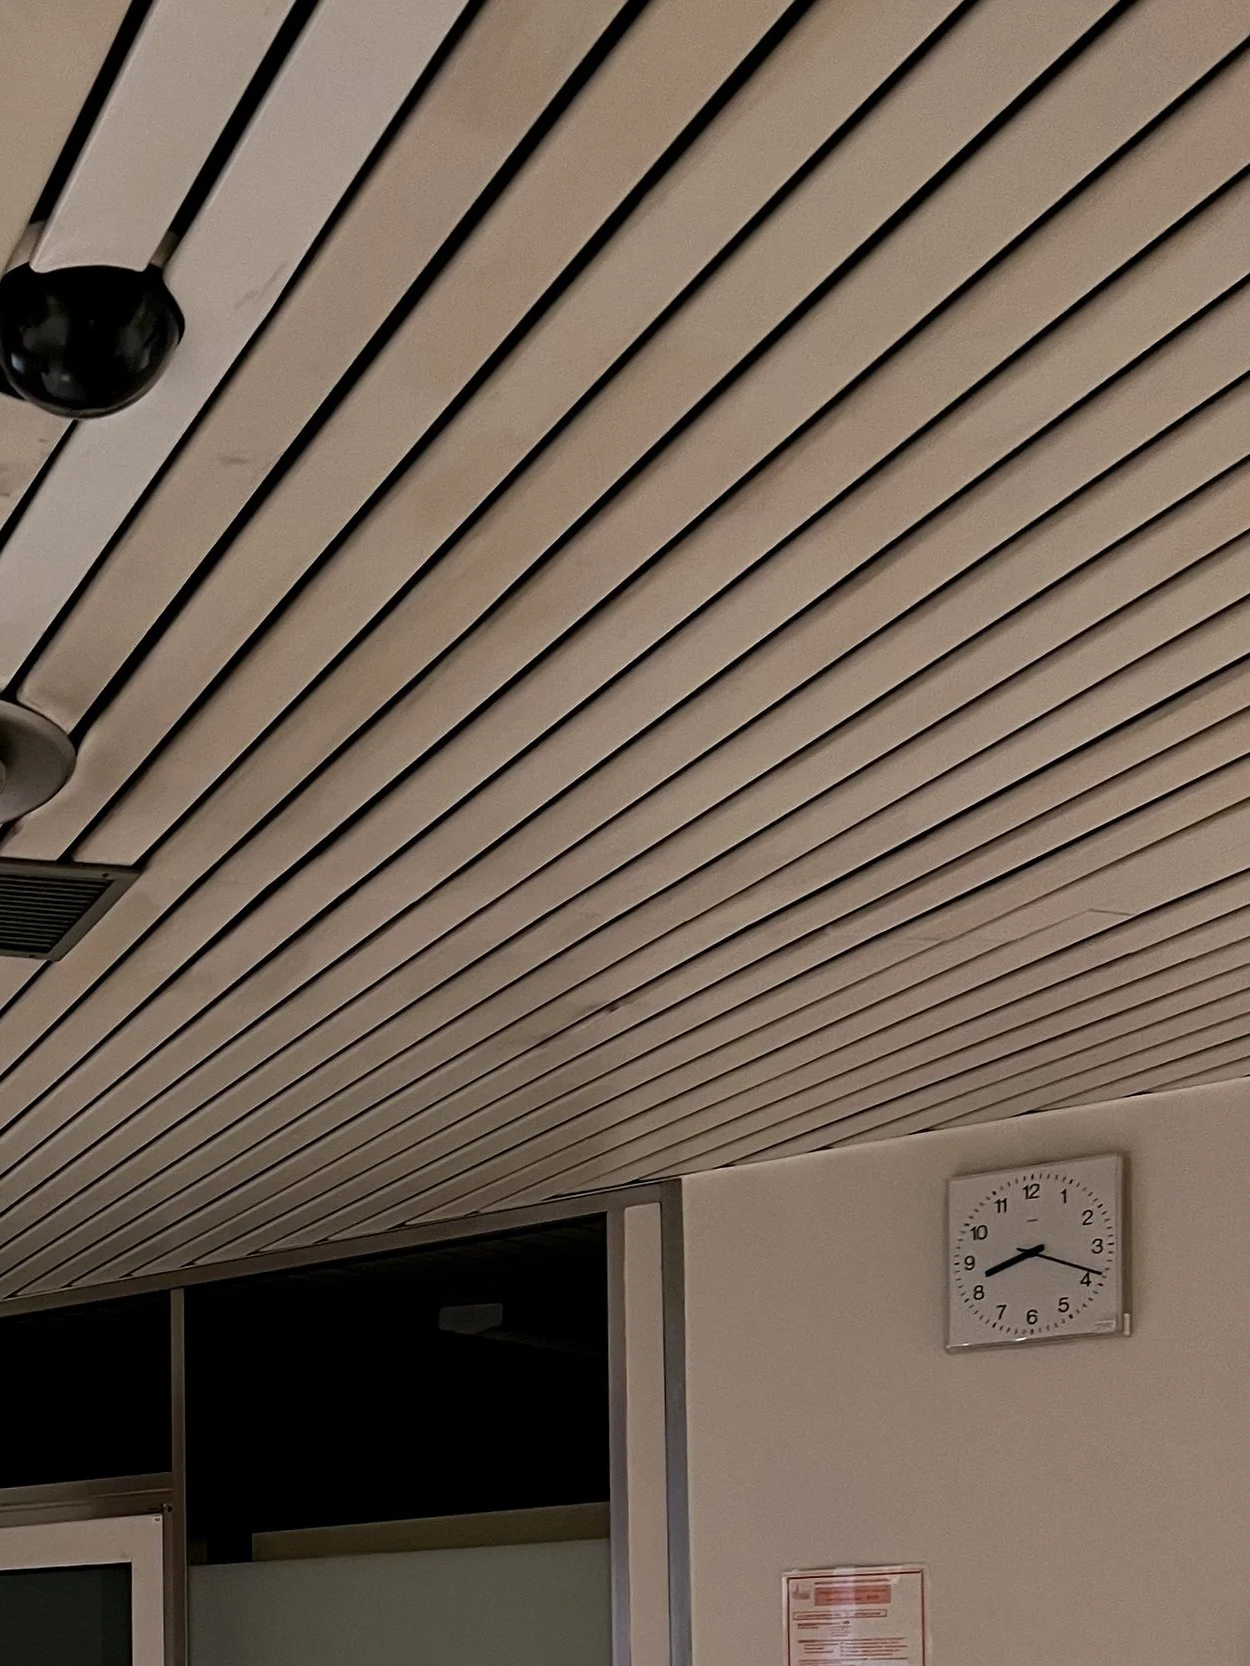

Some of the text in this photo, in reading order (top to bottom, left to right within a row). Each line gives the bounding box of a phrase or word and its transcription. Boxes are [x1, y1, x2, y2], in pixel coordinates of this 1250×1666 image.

[1022, 1183, 1040, 1199] 12
[1061, 1189, 1067, 1203] 1
[994, 1198, 1007, 1213] 11
[1082, 1210, 1093, 1226] 2
[970, 1225, 988, 1240] 10
[1091, 1238, 1103, 1254] 3
[964, 1256, 975, 1270] 9
[1080, 1272, 1092, 1287] 4
[973, 1285, 984, 1300] 8
[996, 1305, 1006, 1320] 7
[1058, 1297, 1069, 1313] 5
[1026, 1310, 1038, 1325] 6
